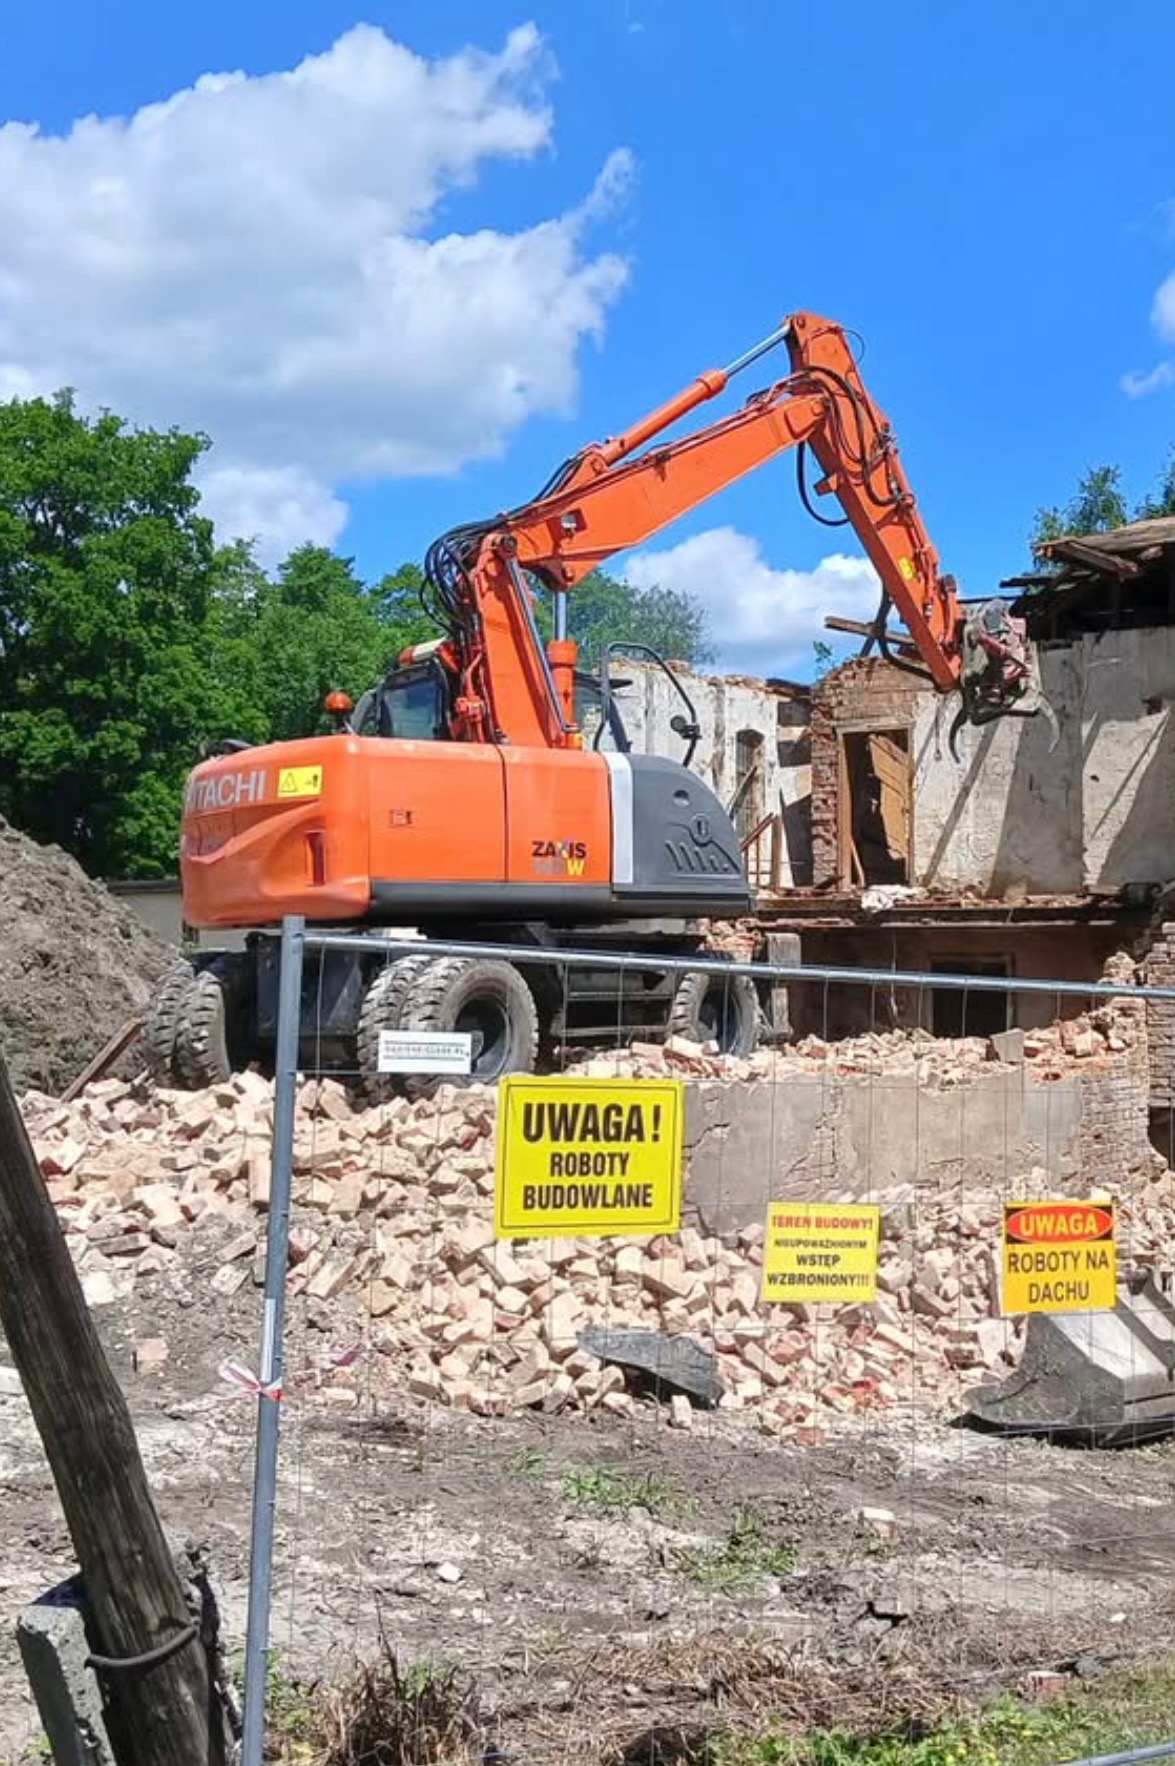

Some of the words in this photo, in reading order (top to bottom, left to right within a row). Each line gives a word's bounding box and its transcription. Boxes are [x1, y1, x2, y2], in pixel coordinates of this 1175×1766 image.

[550, 1152, 629, 1177] ROBOTY
[523, 1184, 653, 1210] BUDOWLANE
[772, 1215, 812, 1228] TEREN
[1020, 1212, 1098, 1237] UWAGA
[796, 1254, 841, 1269] WSTĘP
[1008, 1250, 1081, 1274] ROBOTY
[1086, 1249, 1110, 1271] NA
[1029, 1281, 1089, 1304] DACHU
